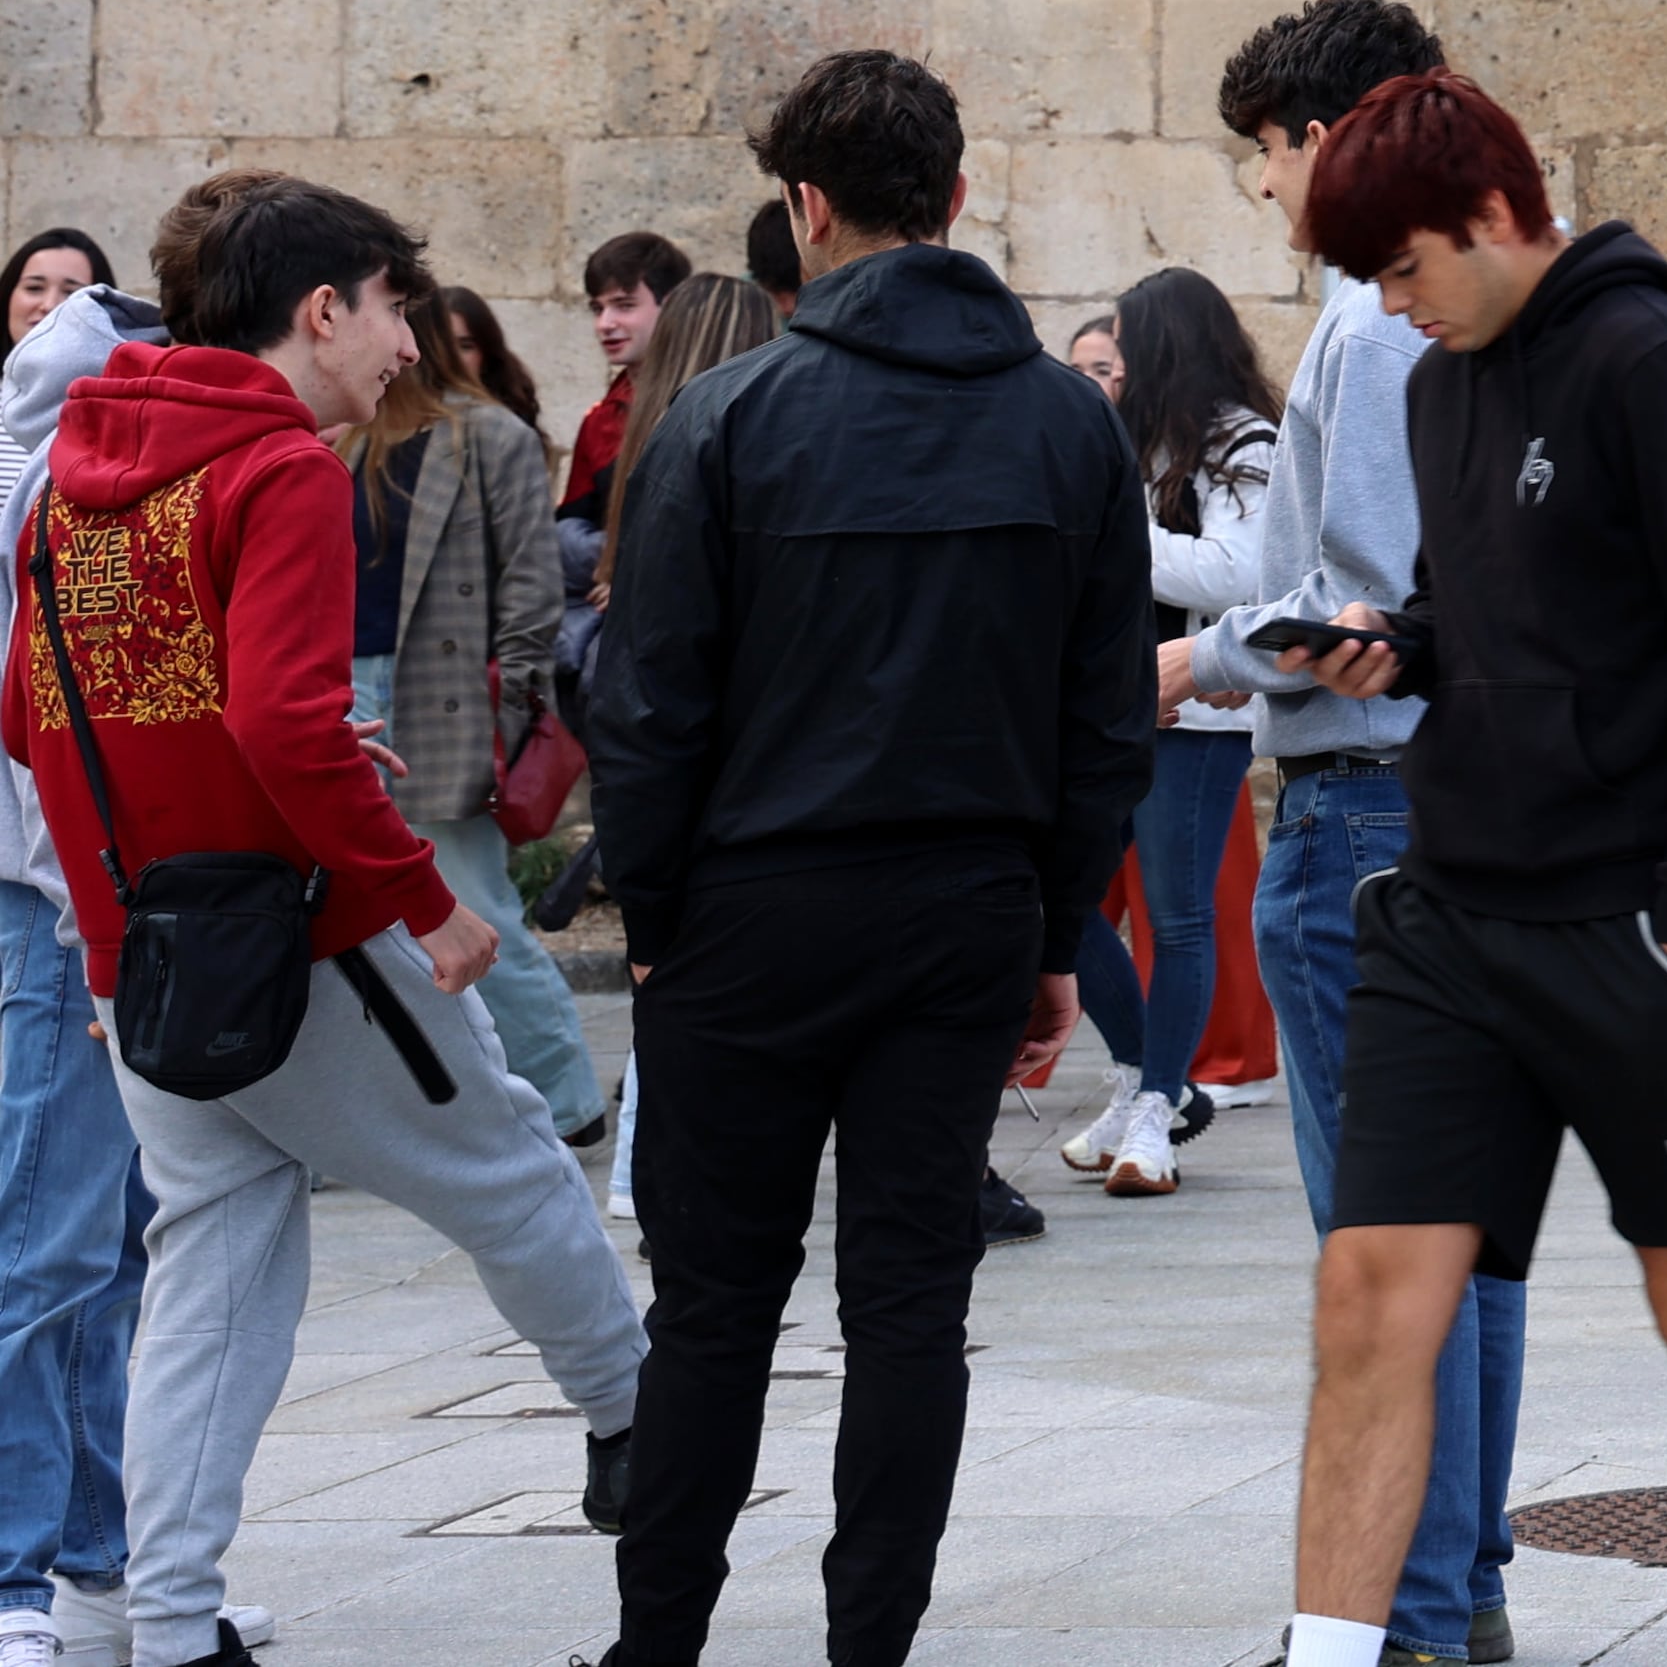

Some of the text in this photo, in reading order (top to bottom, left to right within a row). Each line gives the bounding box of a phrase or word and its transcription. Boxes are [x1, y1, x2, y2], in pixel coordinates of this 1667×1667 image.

[72, 526, 127, 557] WE
[65, 554, 132, 585] THE
[54, 582, 142, 617] BEST
